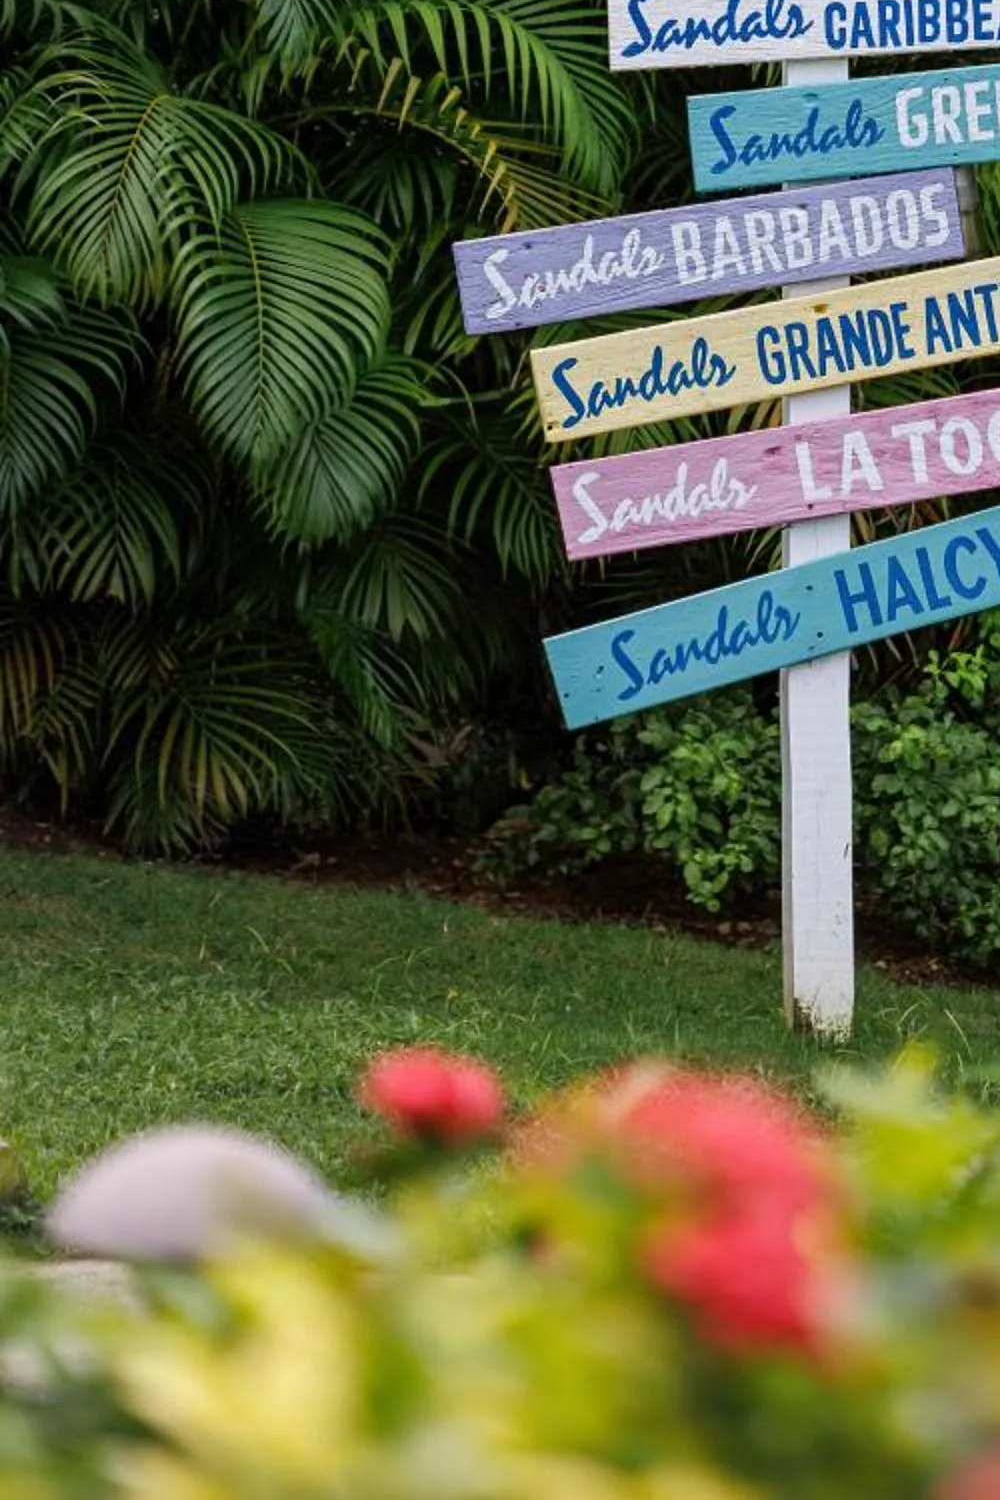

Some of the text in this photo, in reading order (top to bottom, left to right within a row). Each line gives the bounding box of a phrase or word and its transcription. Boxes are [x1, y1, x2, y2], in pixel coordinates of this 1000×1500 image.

[708, 101, 886, 175] Sandals
[483, 183, 950, 319] Sandals BARBADOS
[552, 338, 736, 429] Sandals
[756, 302, 915, 384] GRANDE
[573, 458, 758, 544] Sandals
[796, 431, 883, 500] LA
[611, 590, 800, 700] Sandals
